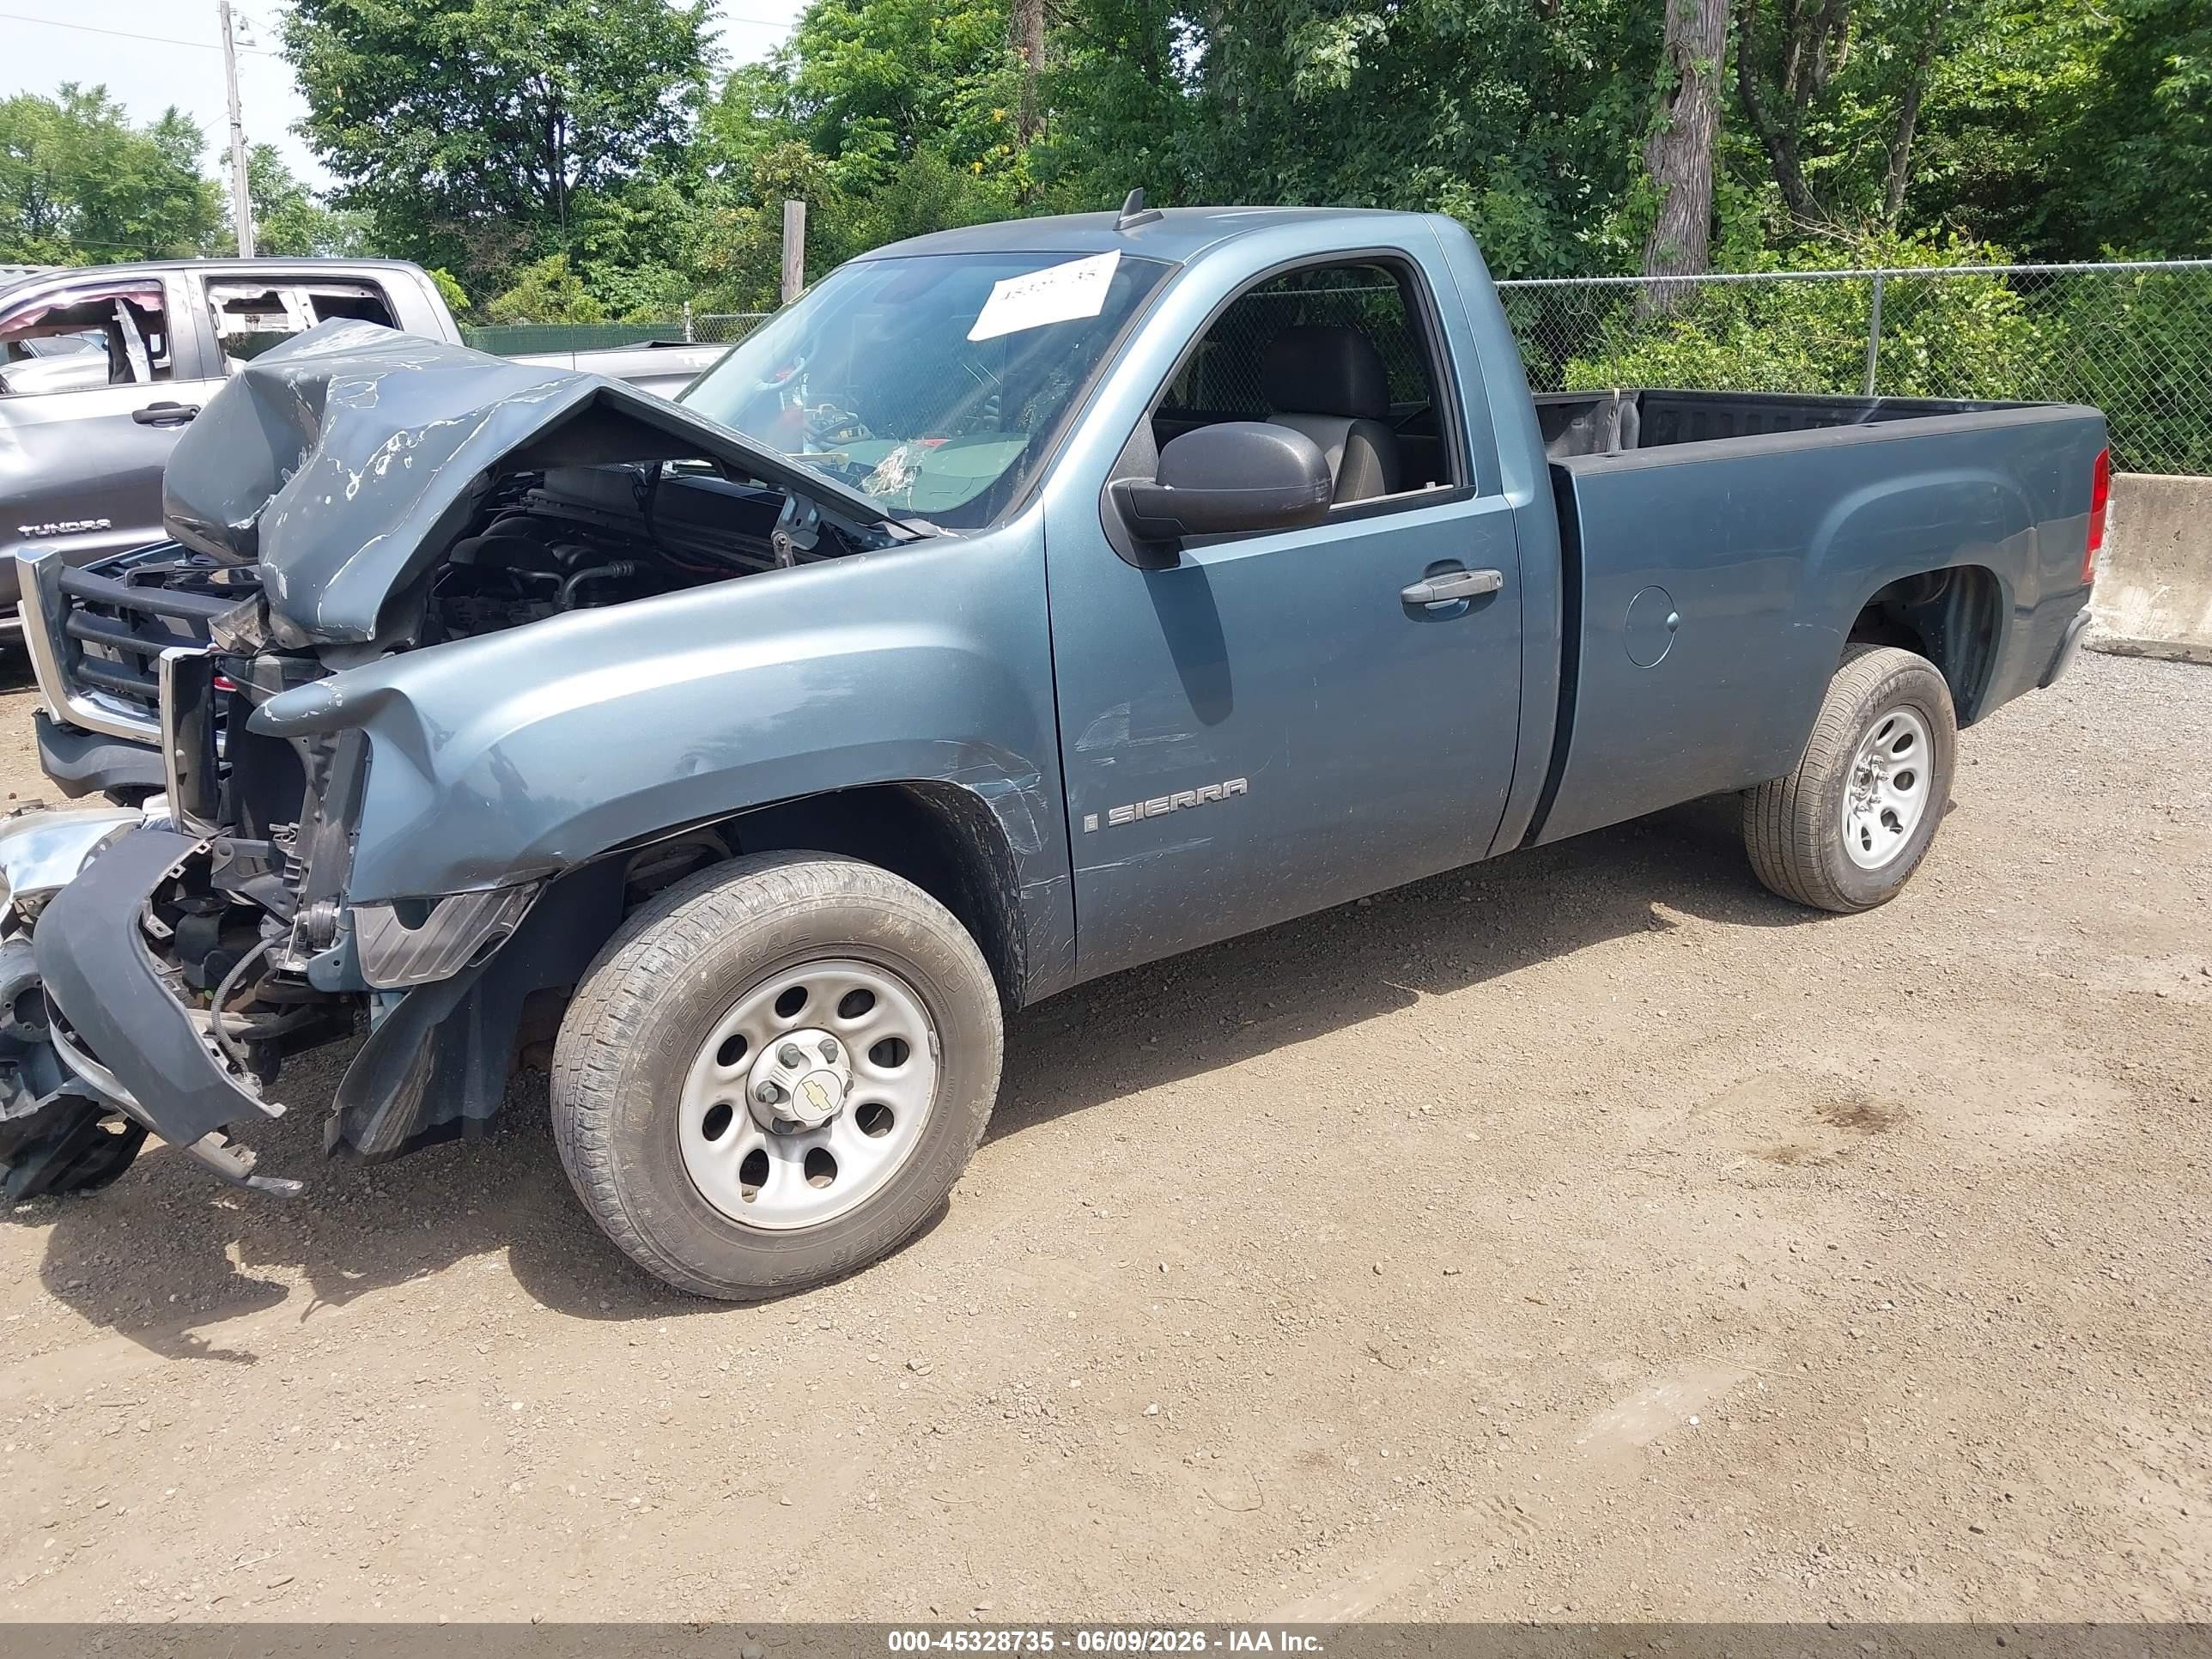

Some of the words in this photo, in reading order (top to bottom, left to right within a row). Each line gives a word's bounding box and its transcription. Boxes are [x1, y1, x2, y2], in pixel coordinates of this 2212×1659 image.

[17, 519, 112, 538] TUNDRA
[1108, 777, 1248, 828] SIERRA
[659, 927, 811, 1056] GENERAL
